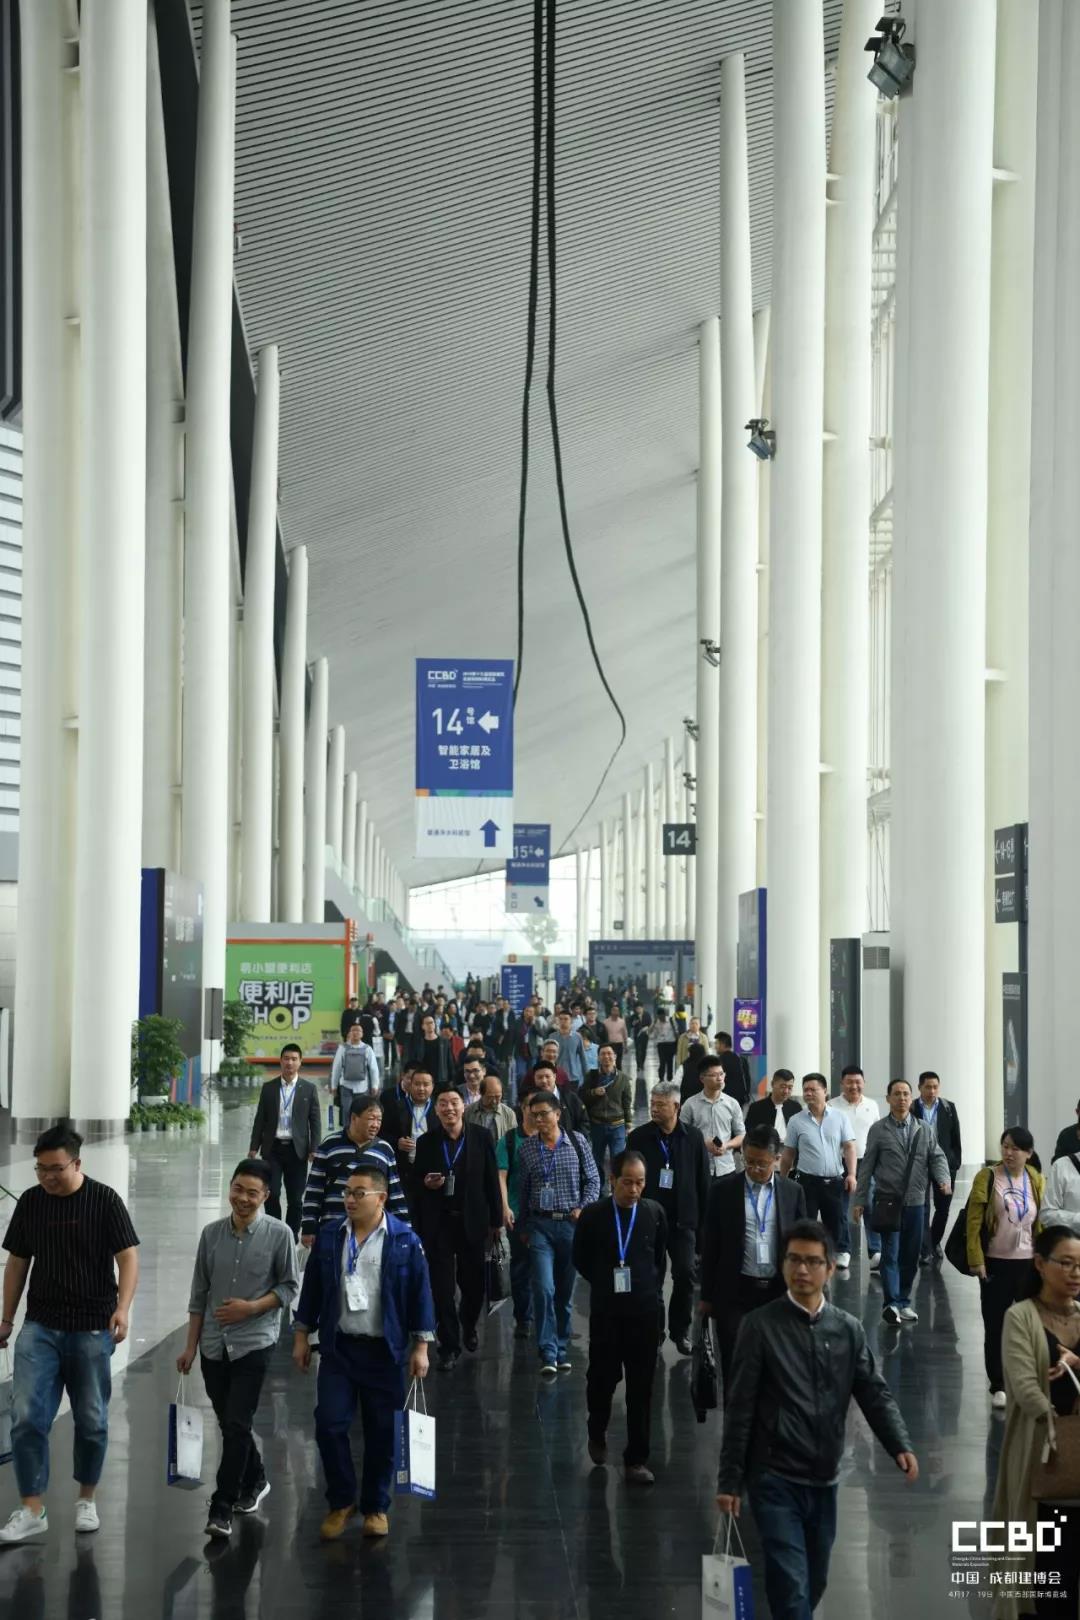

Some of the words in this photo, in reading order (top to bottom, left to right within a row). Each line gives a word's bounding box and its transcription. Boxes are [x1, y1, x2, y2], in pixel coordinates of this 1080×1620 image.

[432, 707, 464, 735] 14
[668, 830, 691, 848] 14
[239, 980, 313, 1005] 便利店
[246, 1006, 310, 1030] HOP
